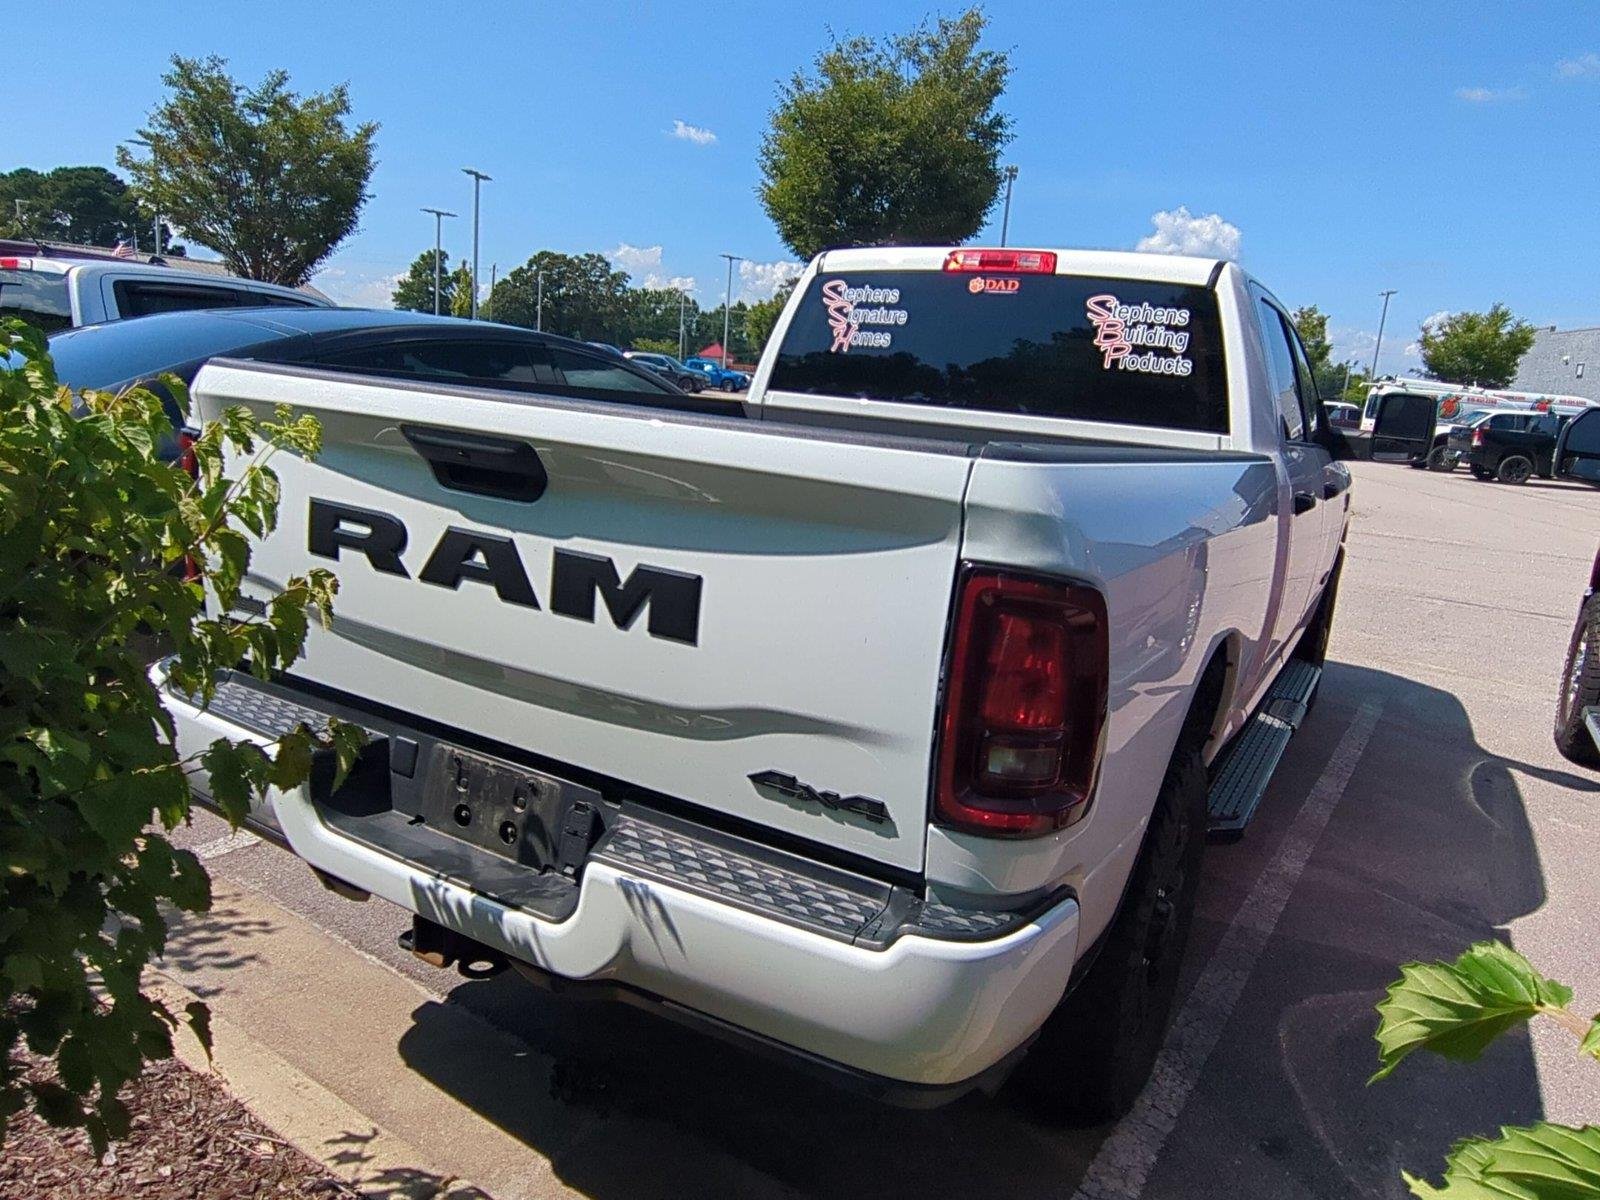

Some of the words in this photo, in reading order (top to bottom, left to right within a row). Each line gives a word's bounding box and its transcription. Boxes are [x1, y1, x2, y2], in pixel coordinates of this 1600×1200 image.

[823, 280, 900, 306] Stephens
[985, 279, 1019, 291] DAD
[828, 302, 908, 330] Signature
[1087, 295, 1190, 325] Stephens
[830, 326, 891, 352] Homes
[1093, 319, 1189, 353] Building
[1100, 342, 1193, 376] Products
[308, 496, 703, 648] RAM
